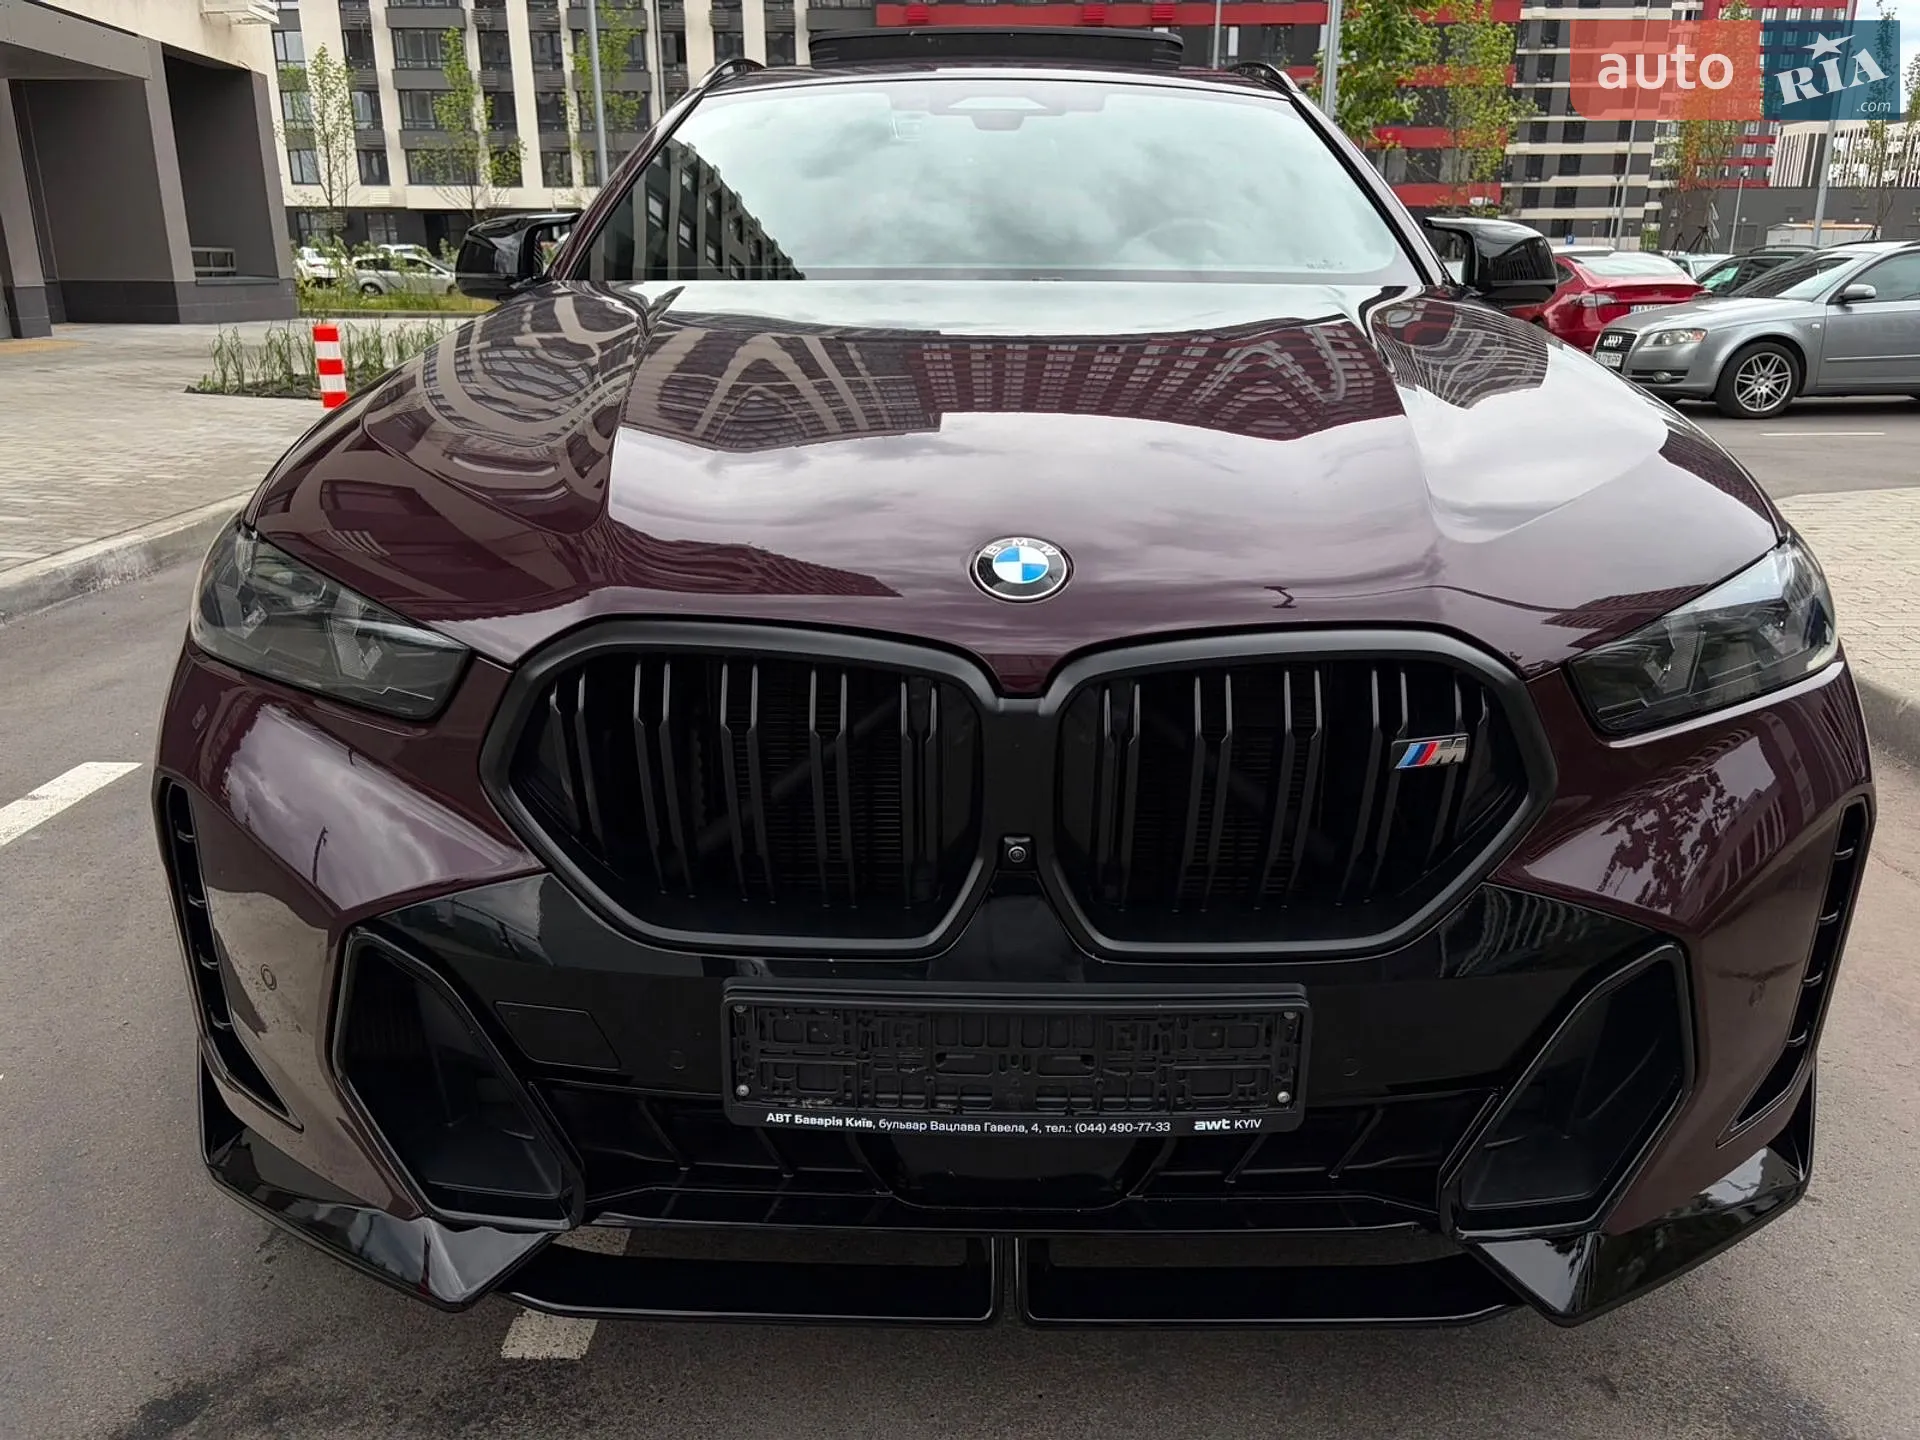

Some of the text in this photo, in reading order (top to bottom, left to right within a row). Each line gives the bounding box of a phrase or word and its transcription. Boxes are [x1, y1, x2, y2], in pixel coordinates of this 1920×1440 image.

[984, 538, 1057, 556] BMW
[794, 1114, 843, 1128] Баварія
[845, 1117, 876, 1130] Київ,
[878, 1118, 928, 1132] бульвар
[930, 1120, 981, 1134] Вацлава
[983, 1121, 1029, 1134] Гавела,
[1031, 1122, 1042, 1134] 4,
[1044, 1123, 1072, 1133] тел.:
[1074, 1121, 1107, 1134] (044)
[1109, 1121, 1171, 1133] 490-77-33
[1193, 1118, 1262, 1131] awt KYIV
